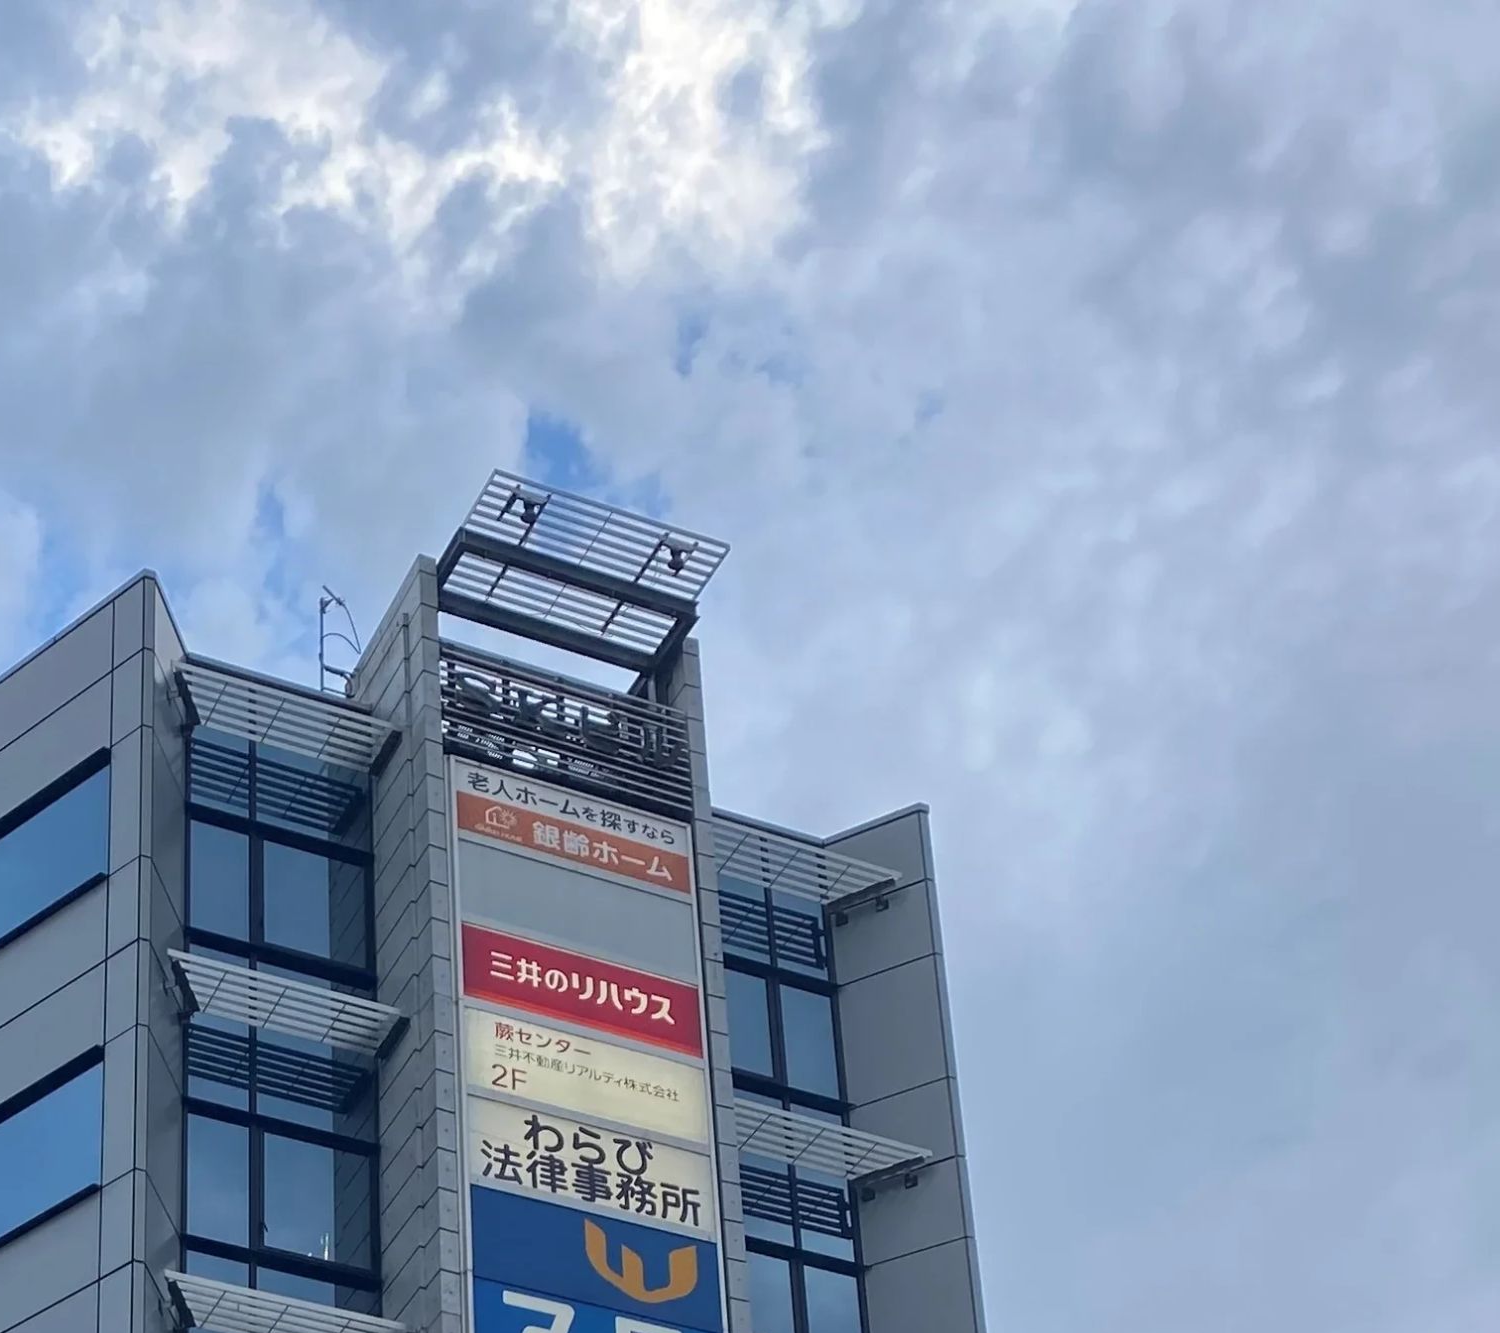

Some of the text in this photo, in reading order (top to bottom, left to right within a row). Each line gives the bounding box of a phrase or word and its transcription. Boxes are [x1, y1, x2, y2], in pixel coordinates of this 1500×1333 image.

[467, 770, 676, 846] 老人ホームを探すなら
[531, 821, 673, 881] 銀齢ホーム
[488, 950, 676, 1025] 三井のリハウス
[494, 1020, 592, 1056] 蕨センター
[491, 1064, 528, 1092] 2F
[494, 1043, 680, 1102] 三井不動産リアルティ株式会社
[525, 1114, 654, 1176] わらび
[481, 1139, 701, 1228] 法律事務所
